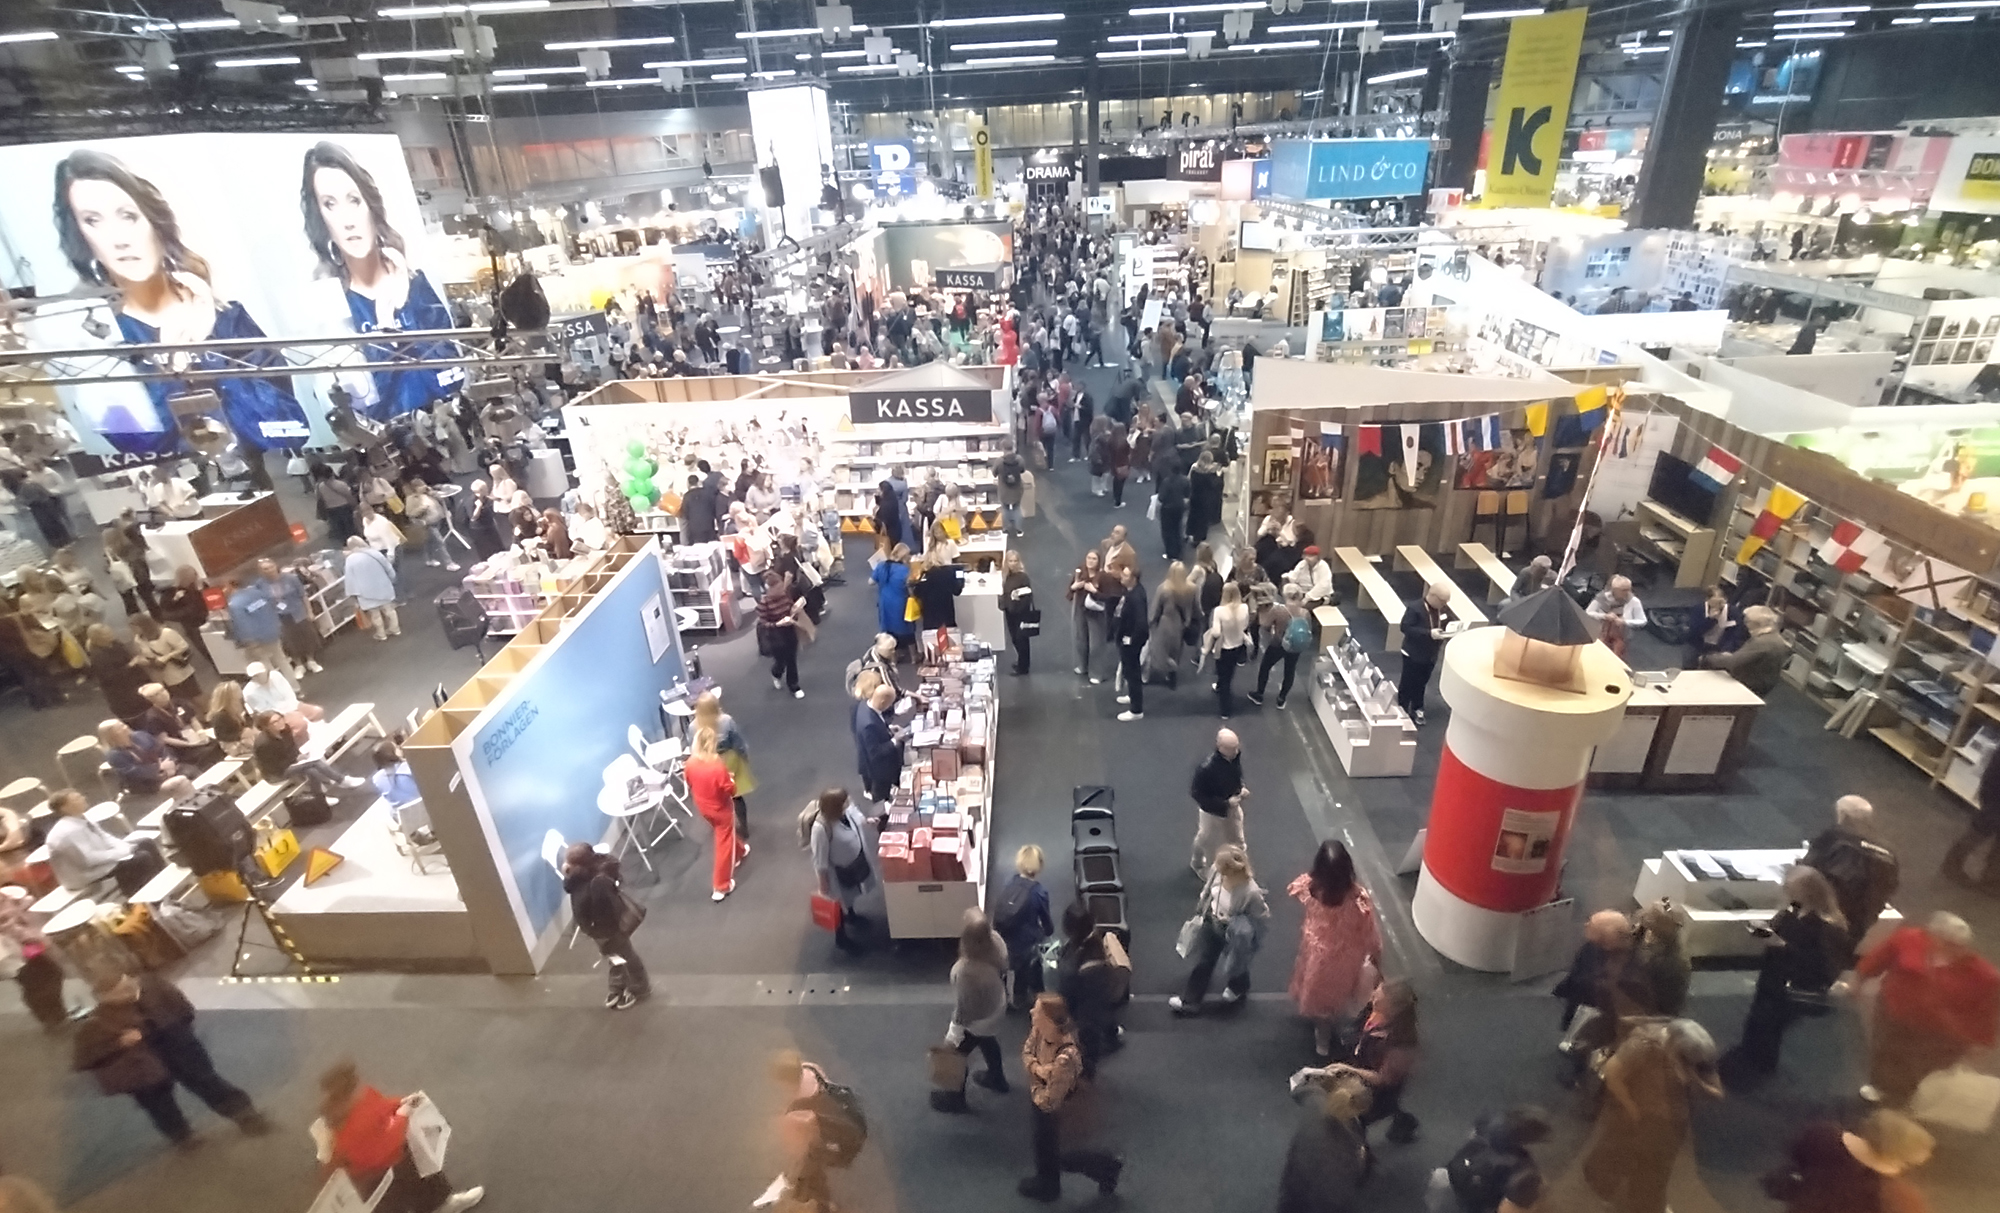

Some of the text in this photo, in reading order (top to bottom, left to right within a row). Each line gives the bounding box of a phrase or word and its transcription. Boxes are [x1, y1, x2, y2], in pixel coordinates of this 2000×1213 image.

[1026, 166, 1071, 179] DRAMA
[946, 274, 984, 287] KASSA
[877, 397, 965, 418] KASSA
